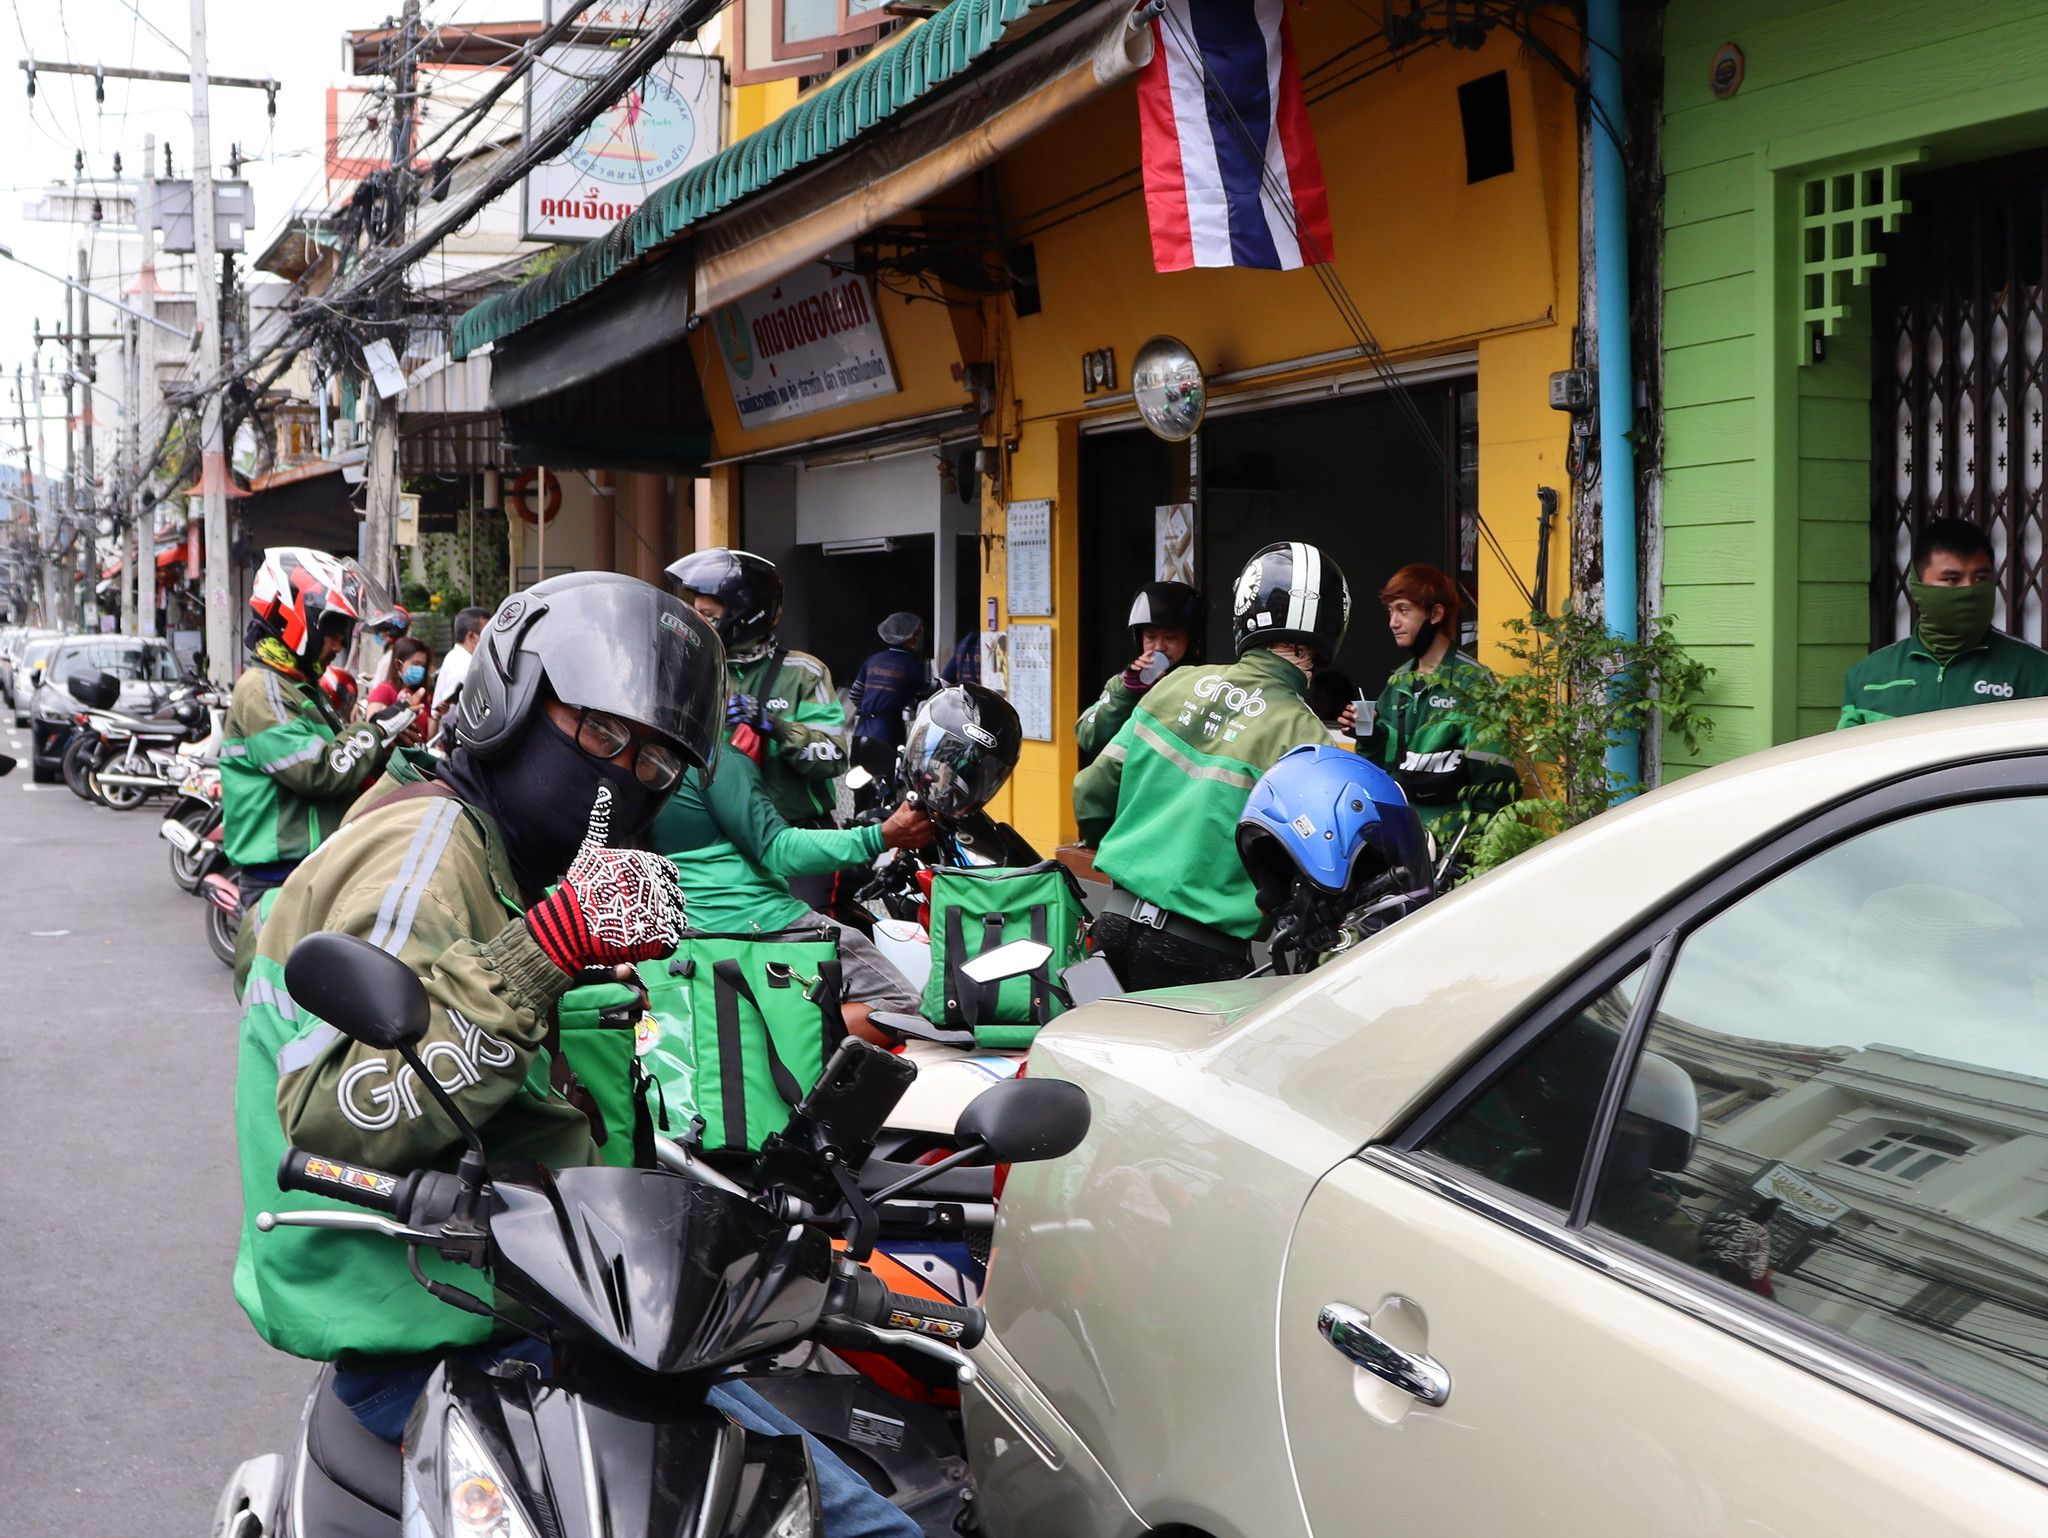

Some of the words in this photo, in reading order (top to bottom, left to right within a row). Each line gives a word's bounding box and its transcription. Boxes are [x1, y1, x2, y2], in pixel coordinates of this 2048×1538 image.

[766, 697, 789, 709] rab
[1194, 675, 1266, 717] Grab
[1973, 680, 2014, 698] Grab
[330, 730, 375, 773] Grab
[1399, 749, 1462, 773] NIKE
[337, 1009, 516, 1131] Grab
